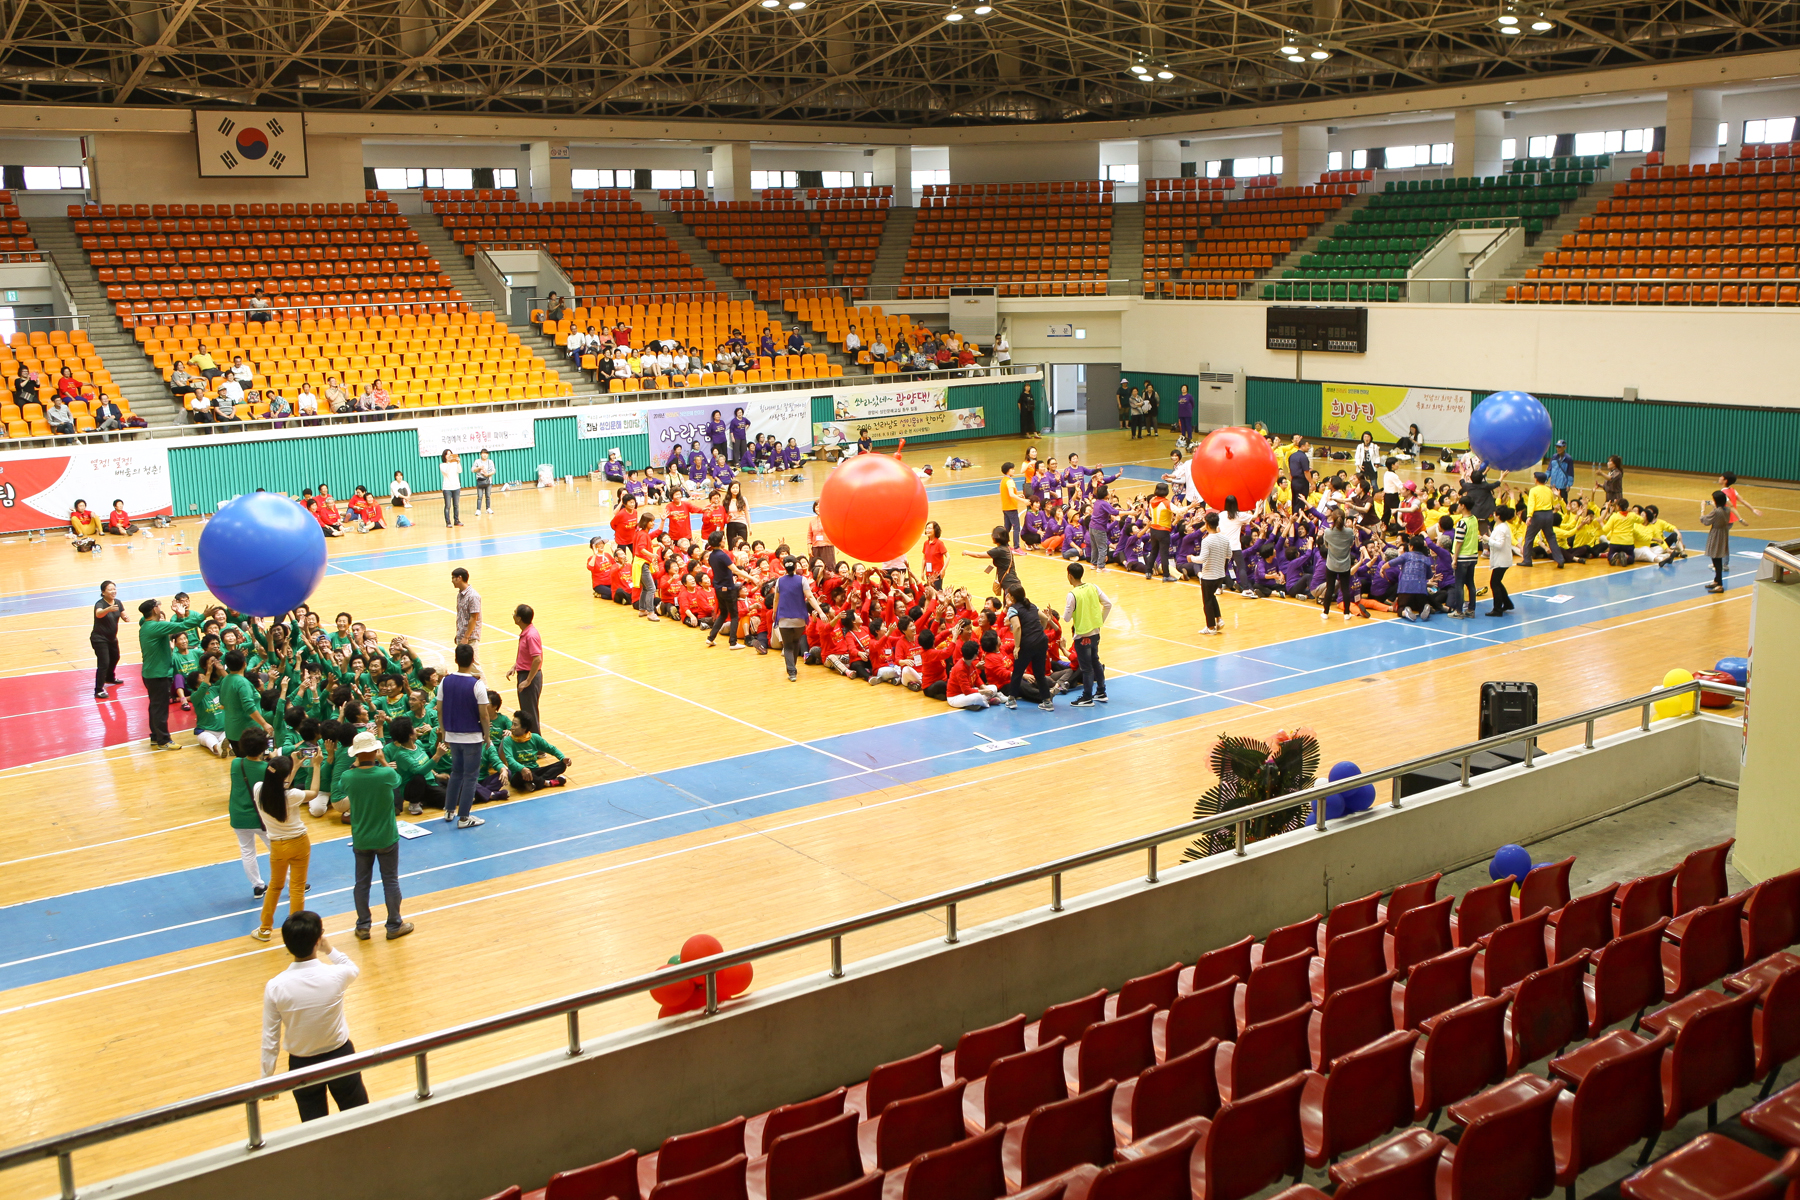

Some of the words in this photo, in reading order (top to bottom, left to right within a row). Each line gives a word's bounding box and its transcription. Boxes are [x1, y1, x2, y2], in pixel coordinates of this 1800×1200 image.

[896, 391, 930, 406] 광양댁!
[1331, 398, 1375, 423] 희망팀
[586, 423, 598, 432] 전남
[600, 420, 622, 431] 성인문해
[623, 419, 640, 429] 한마당
[874, 420, 898, 429] 전라남도
[900, 417, 923, 427] 성인문해
[925, 414, 946, 425] 한마당
[90, 458, 110, 470] 열정!
[113, 457, 132, 468] 열정!
[115, 467, 140, 477] 배움의
[143, 465, 161, 475] 청춘!
